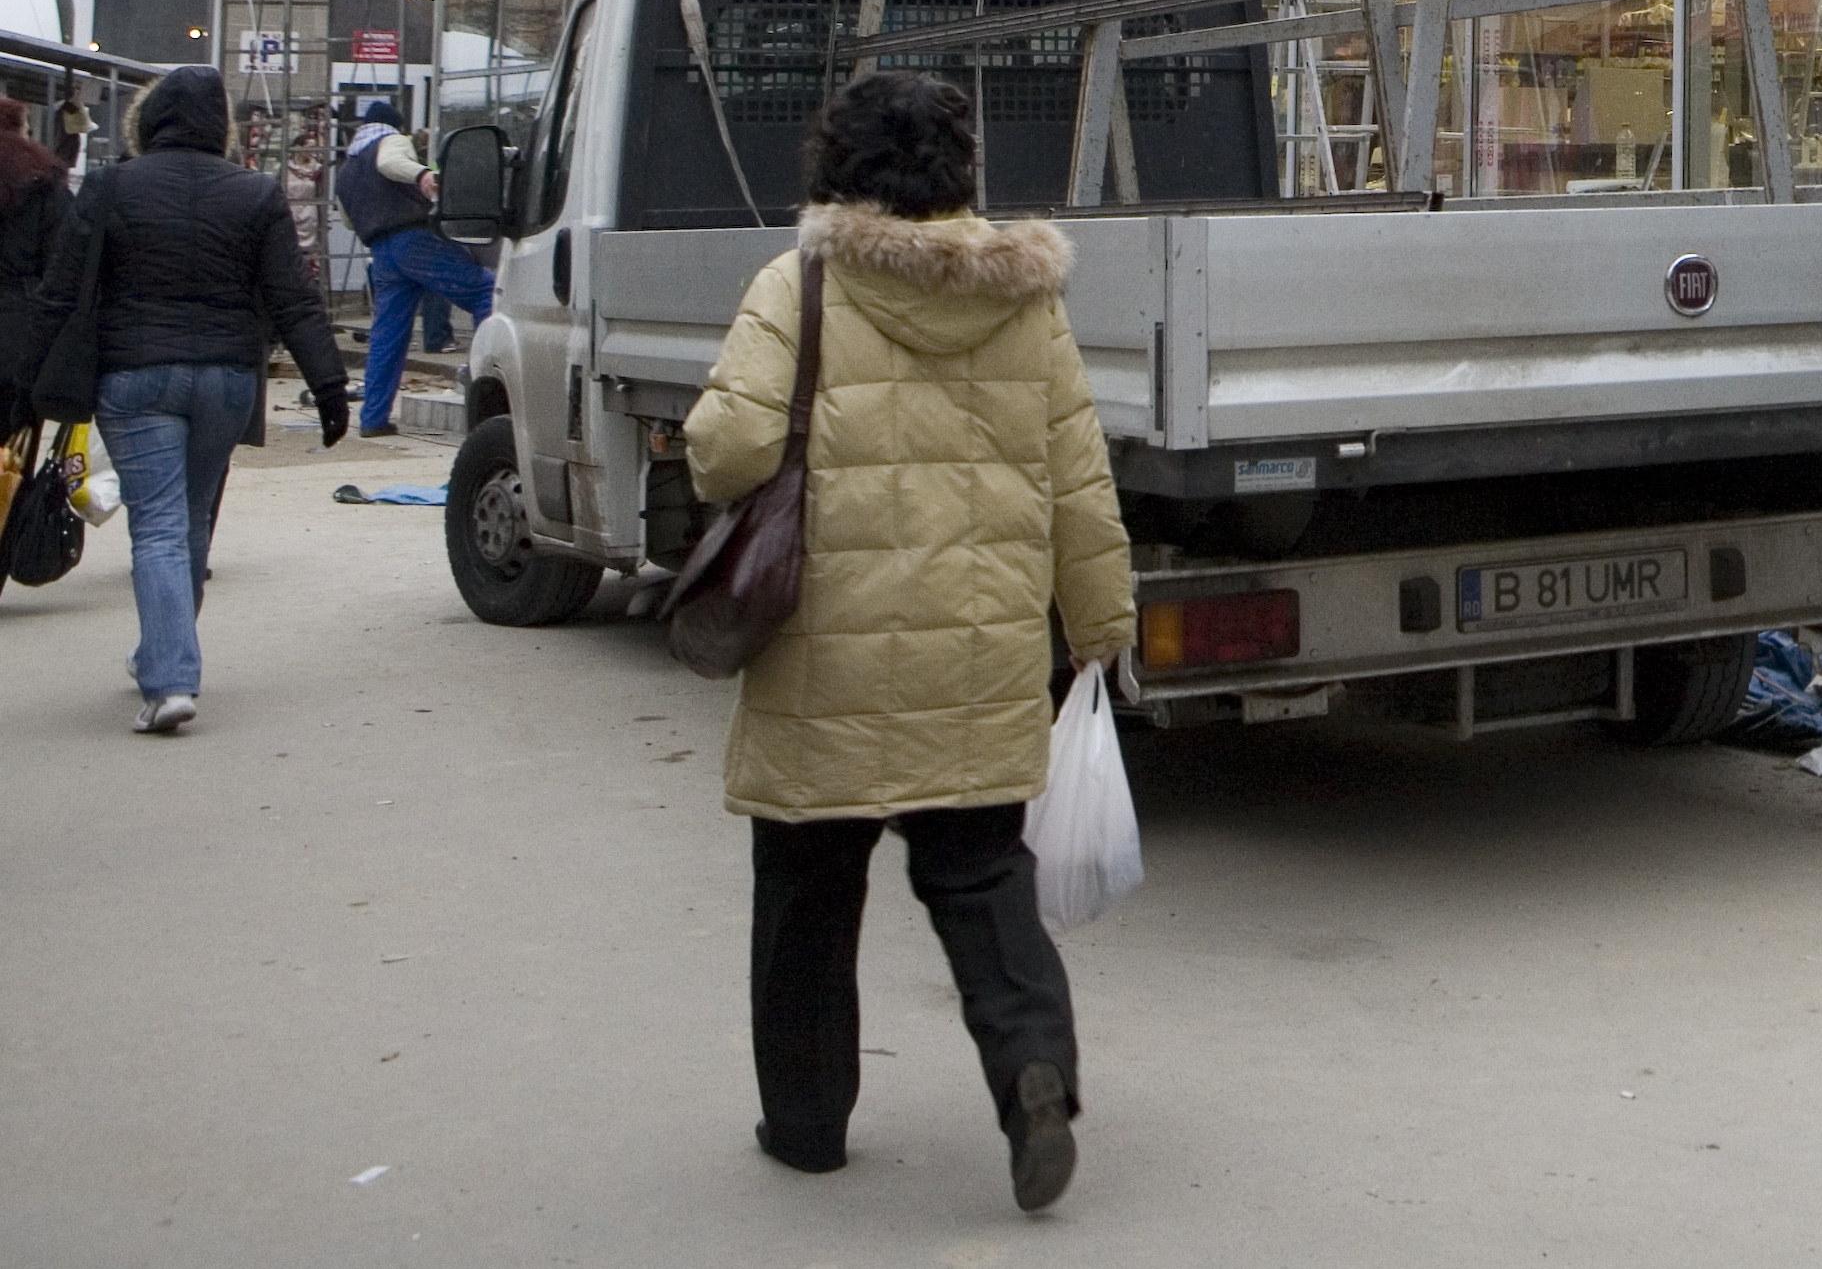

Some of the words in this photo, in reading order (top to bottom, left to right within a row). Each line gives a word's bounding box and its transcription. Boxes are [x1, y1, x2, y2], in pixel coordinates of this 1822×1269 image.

[1678, 272, 1708, 300] FIAT
[1464, 600, 1481, 617] RO
[1494, 571, 1521, 613] B
[1537, 566, 1571, 608] 81
[1585, 559, 1662, 603] UMR
